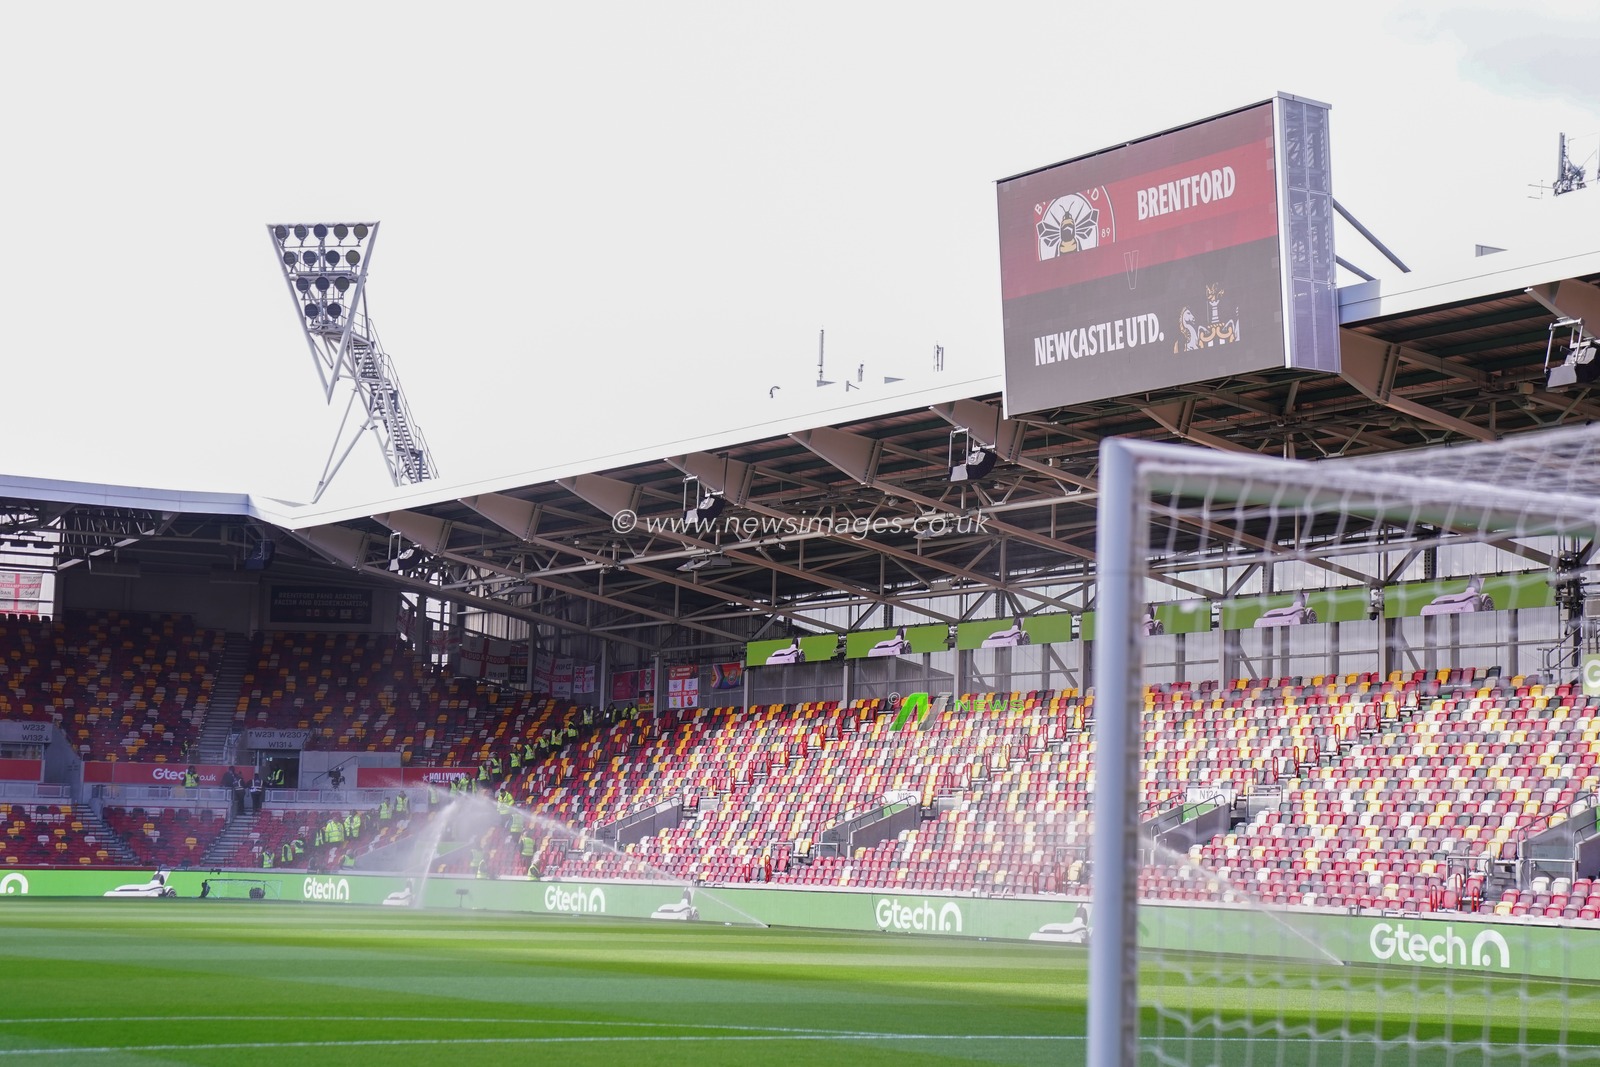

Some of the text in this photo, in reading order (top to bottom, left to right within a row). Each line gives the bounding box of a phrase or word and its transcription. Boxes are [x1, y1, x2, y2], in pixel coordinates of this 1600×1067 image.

[1137, 166, 1236, 221] BRENTFORD
[1034, 312, 1165, 367] NEWCASTLE UTD.
[278, 591, 315, 599] BRENTFORD
[21, 734, 44, 742] W132
[22, 724, 46, 732] W232
[254, 731, 302, 740] W231 W230
[429, 772, 466, 781] HOLLYWOO
[303, 877, 336, 900] Gtech
[544, 885, 588, 912] Gtech
[876, 898, 936, 931] Gtech
[1369, 922, 1467, 966] Gtech
